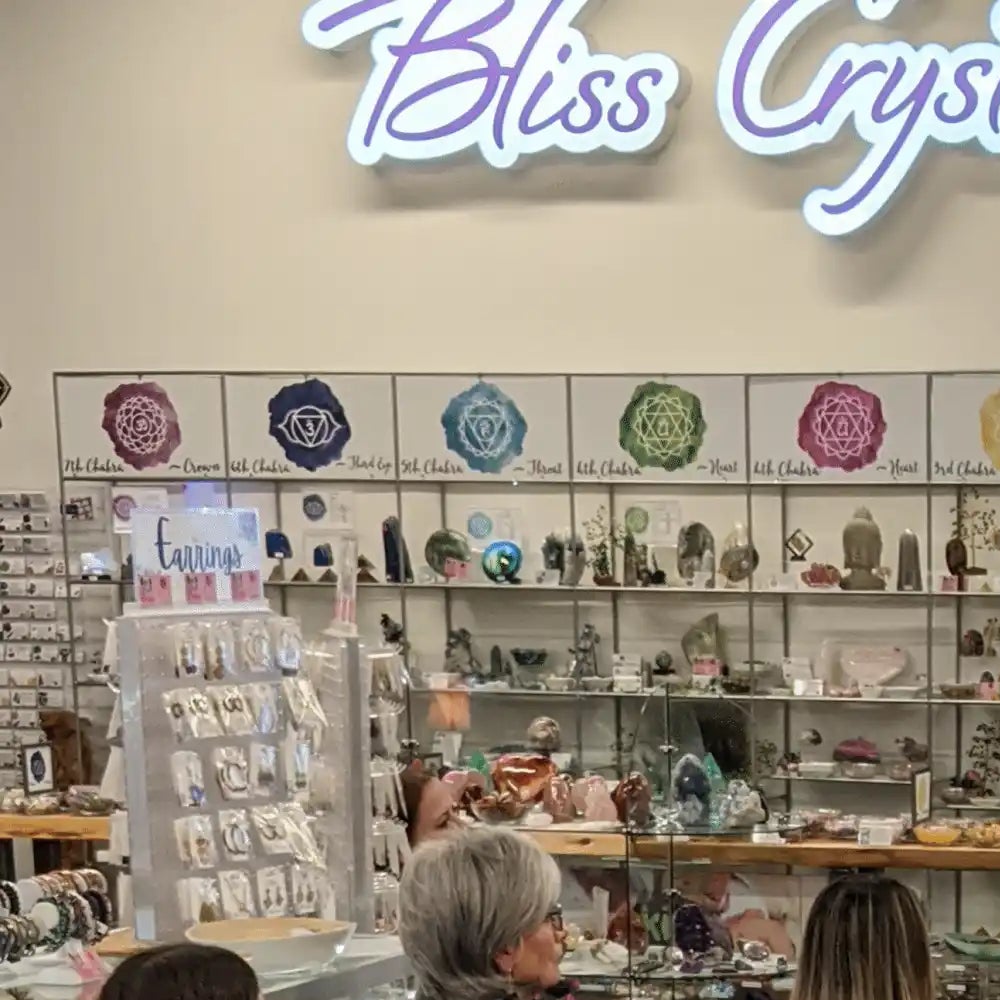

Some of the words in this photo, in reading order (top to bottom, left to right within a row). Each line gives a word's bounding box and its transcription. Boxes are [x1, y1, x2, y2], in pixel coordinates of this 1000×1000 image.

[318, 0, 662, 149] Bliss
[86, 457, 124, 473] Chakra
[252, 457, 291, 473] Chakra
[424, 458, 463, 475] Chakra
[600, 458, 642, 477] Chakra
[777, 459, 820, 477] Chakra
[957, 460, 996, 477] Chakra
[154, 516, 243, 576] Earrings
